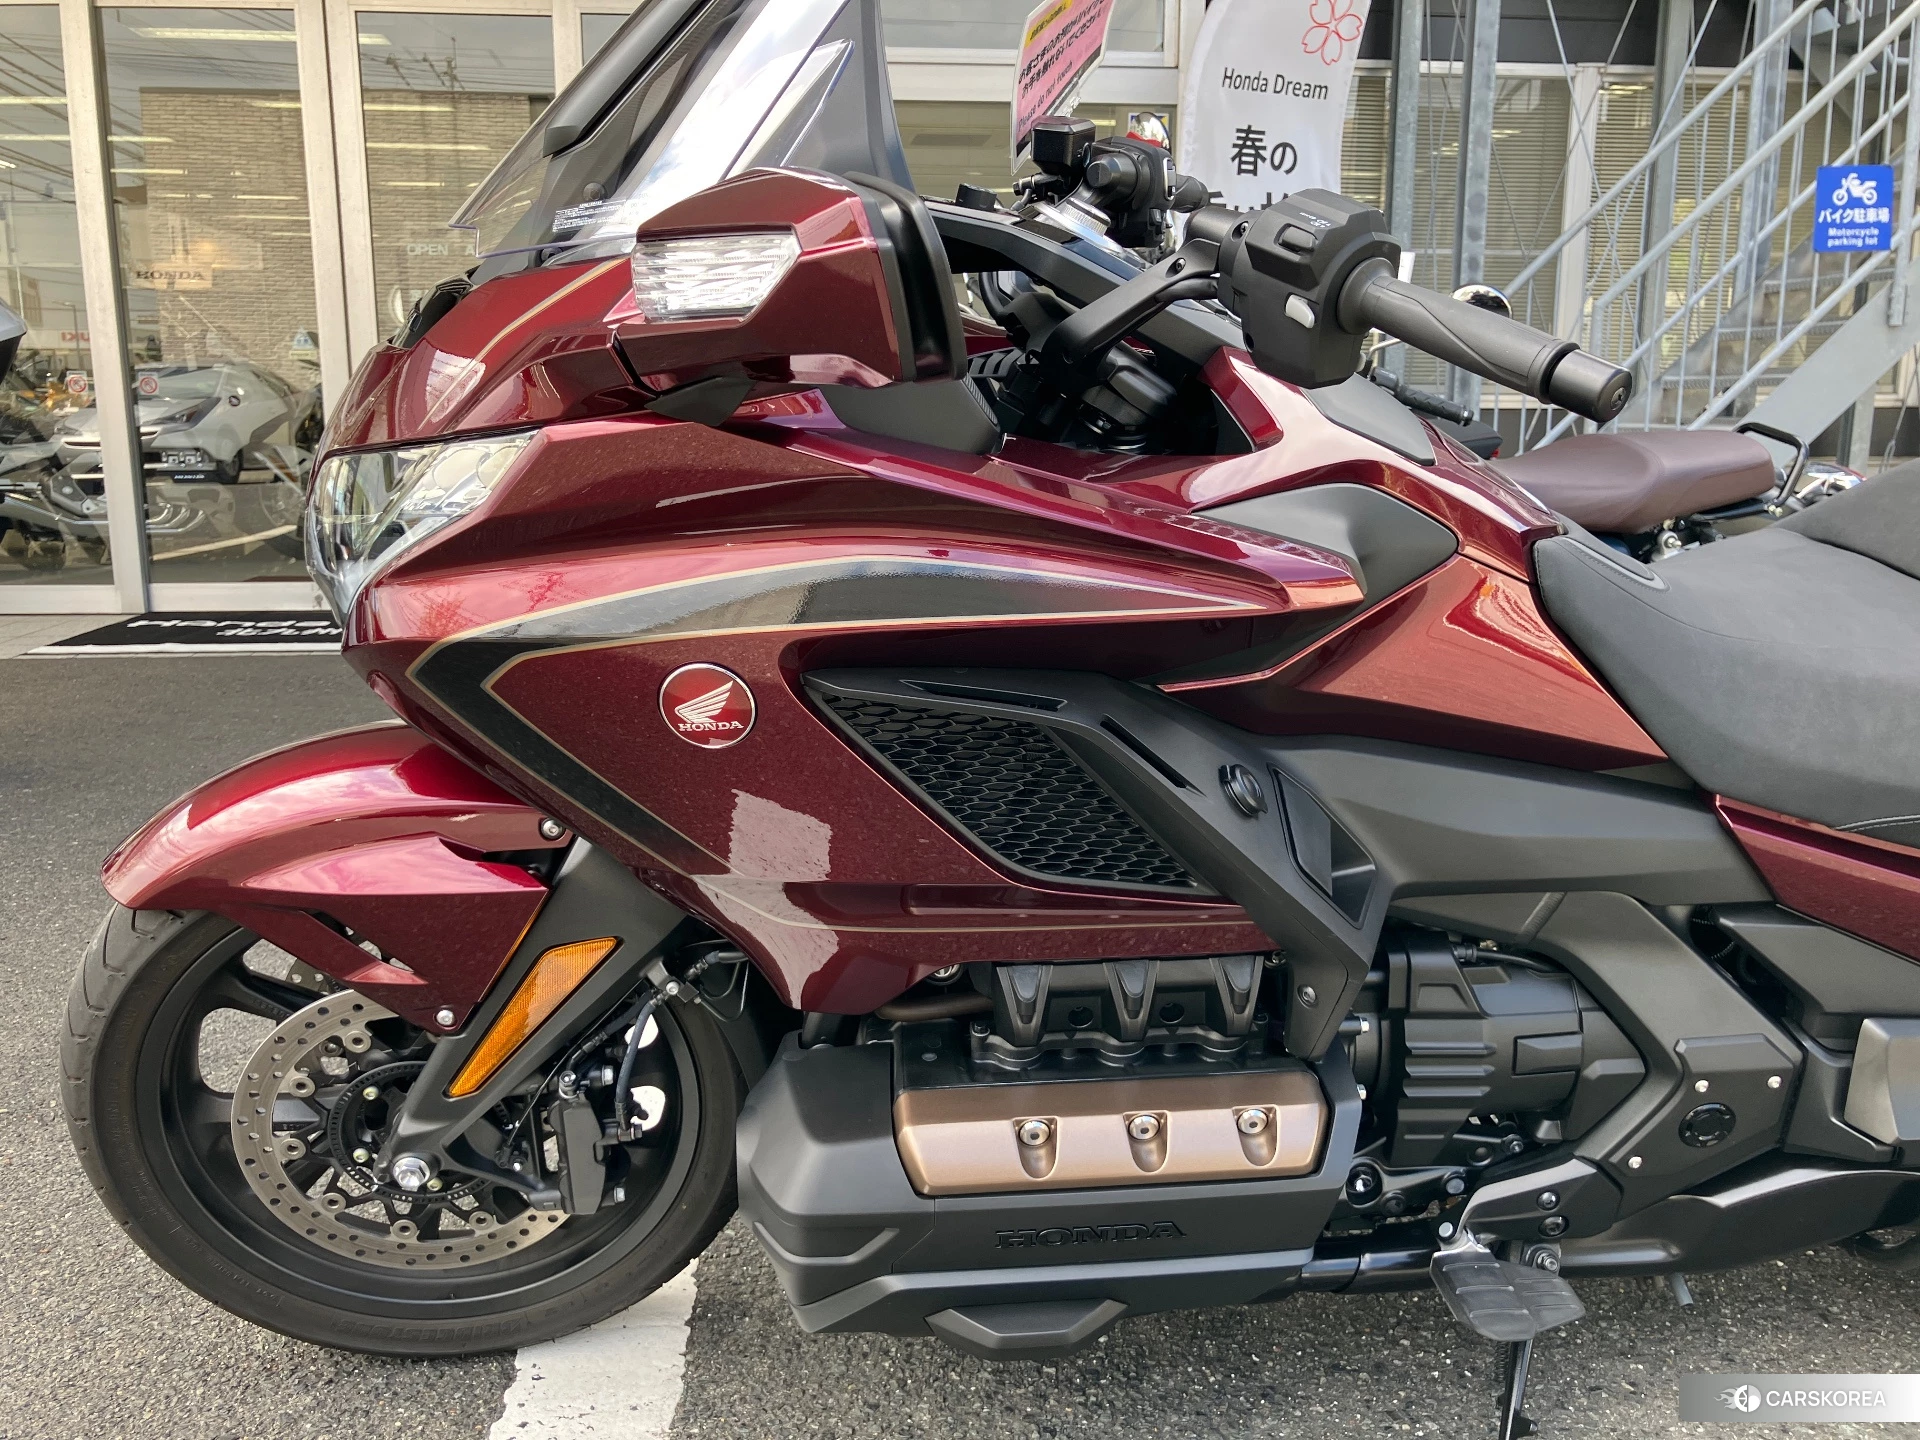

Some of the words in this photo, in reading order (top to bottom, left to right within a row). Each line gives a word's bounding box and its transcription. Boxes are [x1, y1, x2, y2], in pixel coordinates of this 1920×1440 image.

[1222, 67, 1268, 93] Honda
[1273, 74, 1329, 100] Dream
[1018, 105, 1037, 132] Please
[1037, 94, 1045, 108] do
[1046, 78, 1056, 98] not
[1231, 124, 1298, 177] 春の
[1818, 207, 1890, 224] バイク駐車場
[1828, 226, 1879, 237] Motorcycle
[1827, 237, 1863, 247] parking
[1865, 236, 1878, 245] lot
[407, 243, 449, 256] OPEN
[136, 270, 205, 281] HONDA
[677, 720, 745, 732] HONDA
[995, 1221, 1187, 1249] HONDA
